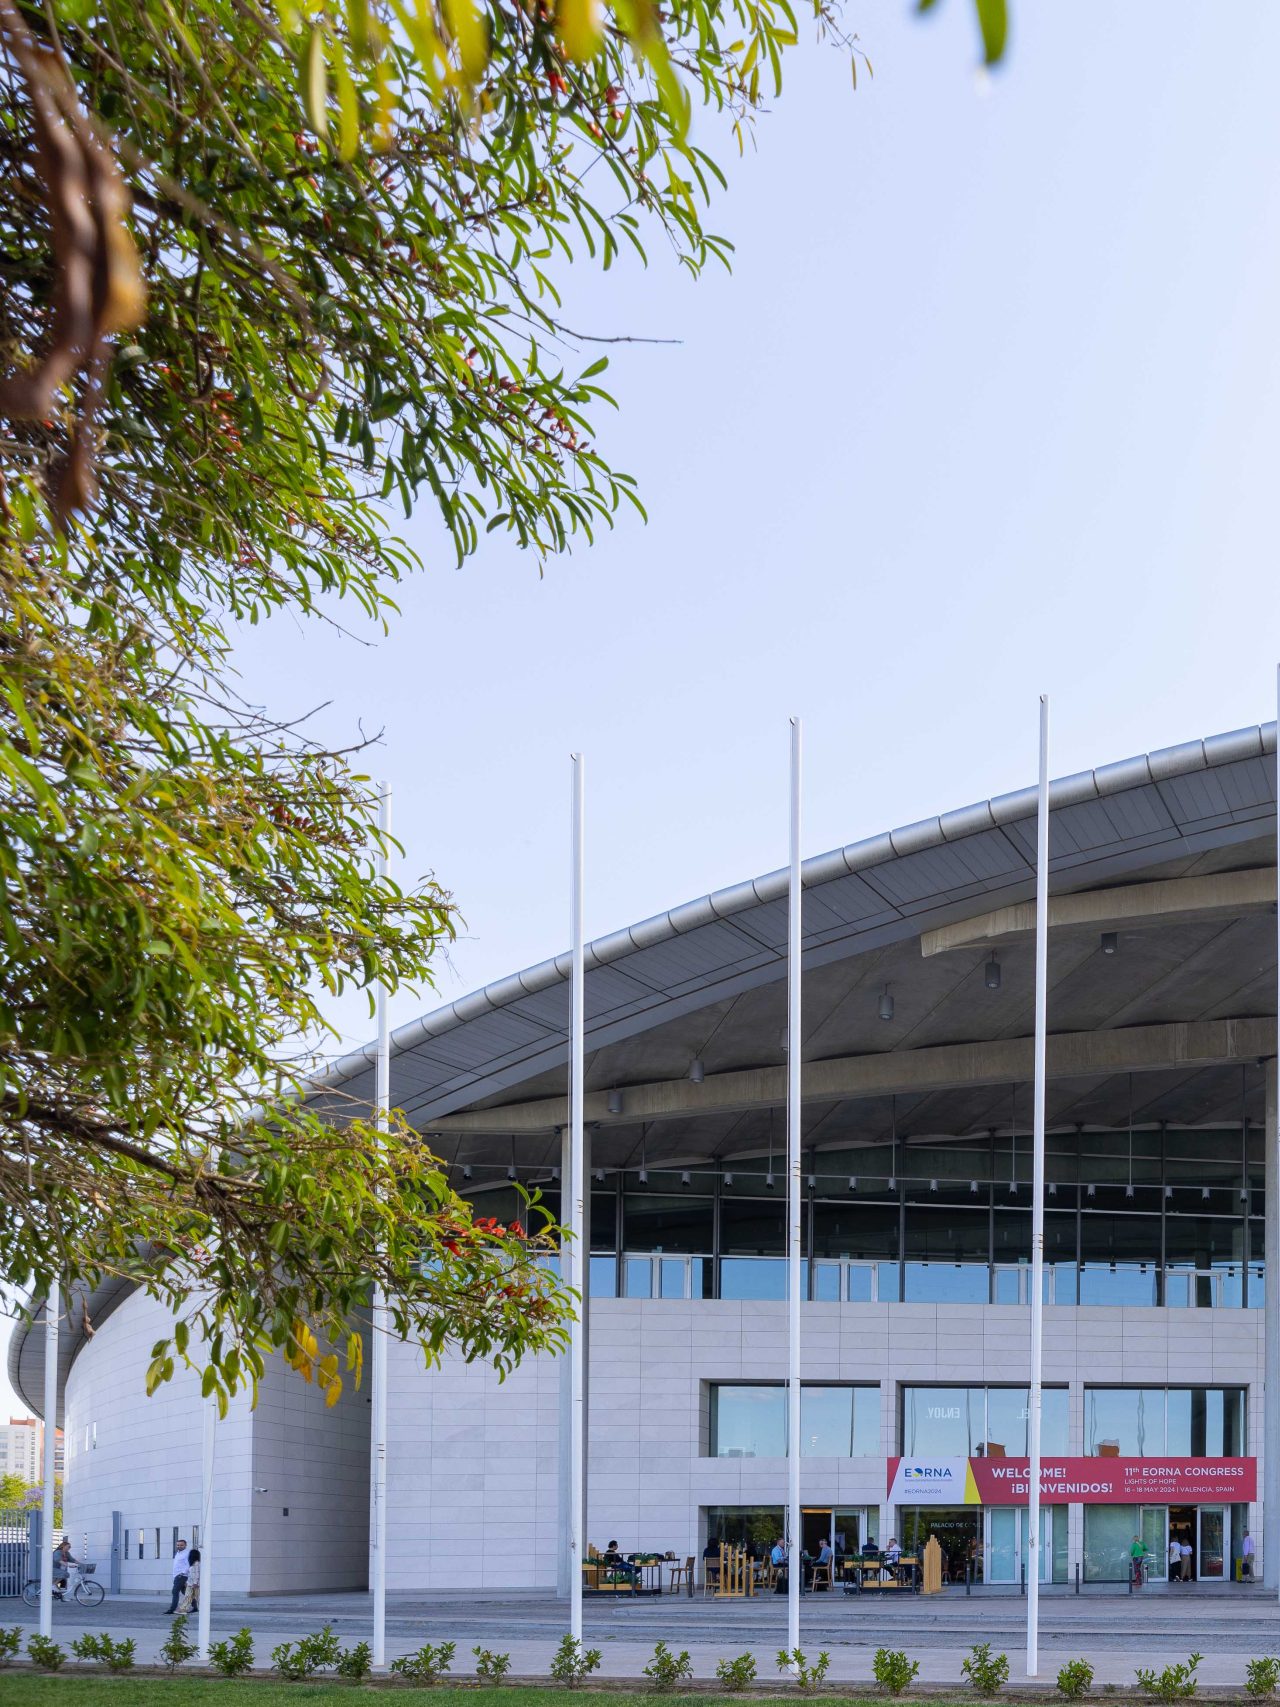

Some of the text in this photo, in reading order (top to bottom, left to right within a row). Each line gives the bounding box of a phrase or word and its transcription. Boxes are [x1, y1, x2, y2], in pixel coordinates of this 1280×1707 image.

[904, 1467, 952, 1478] EORNA
[992, 1467, 1066, 1478] WELCME!
[1142, 1467, 1182, 1476] EORNA
[1184, 1467, 1244, 1476] CONGRESS
[1011, 1482, 1113, 1494] ¡BINVENIDOS!
